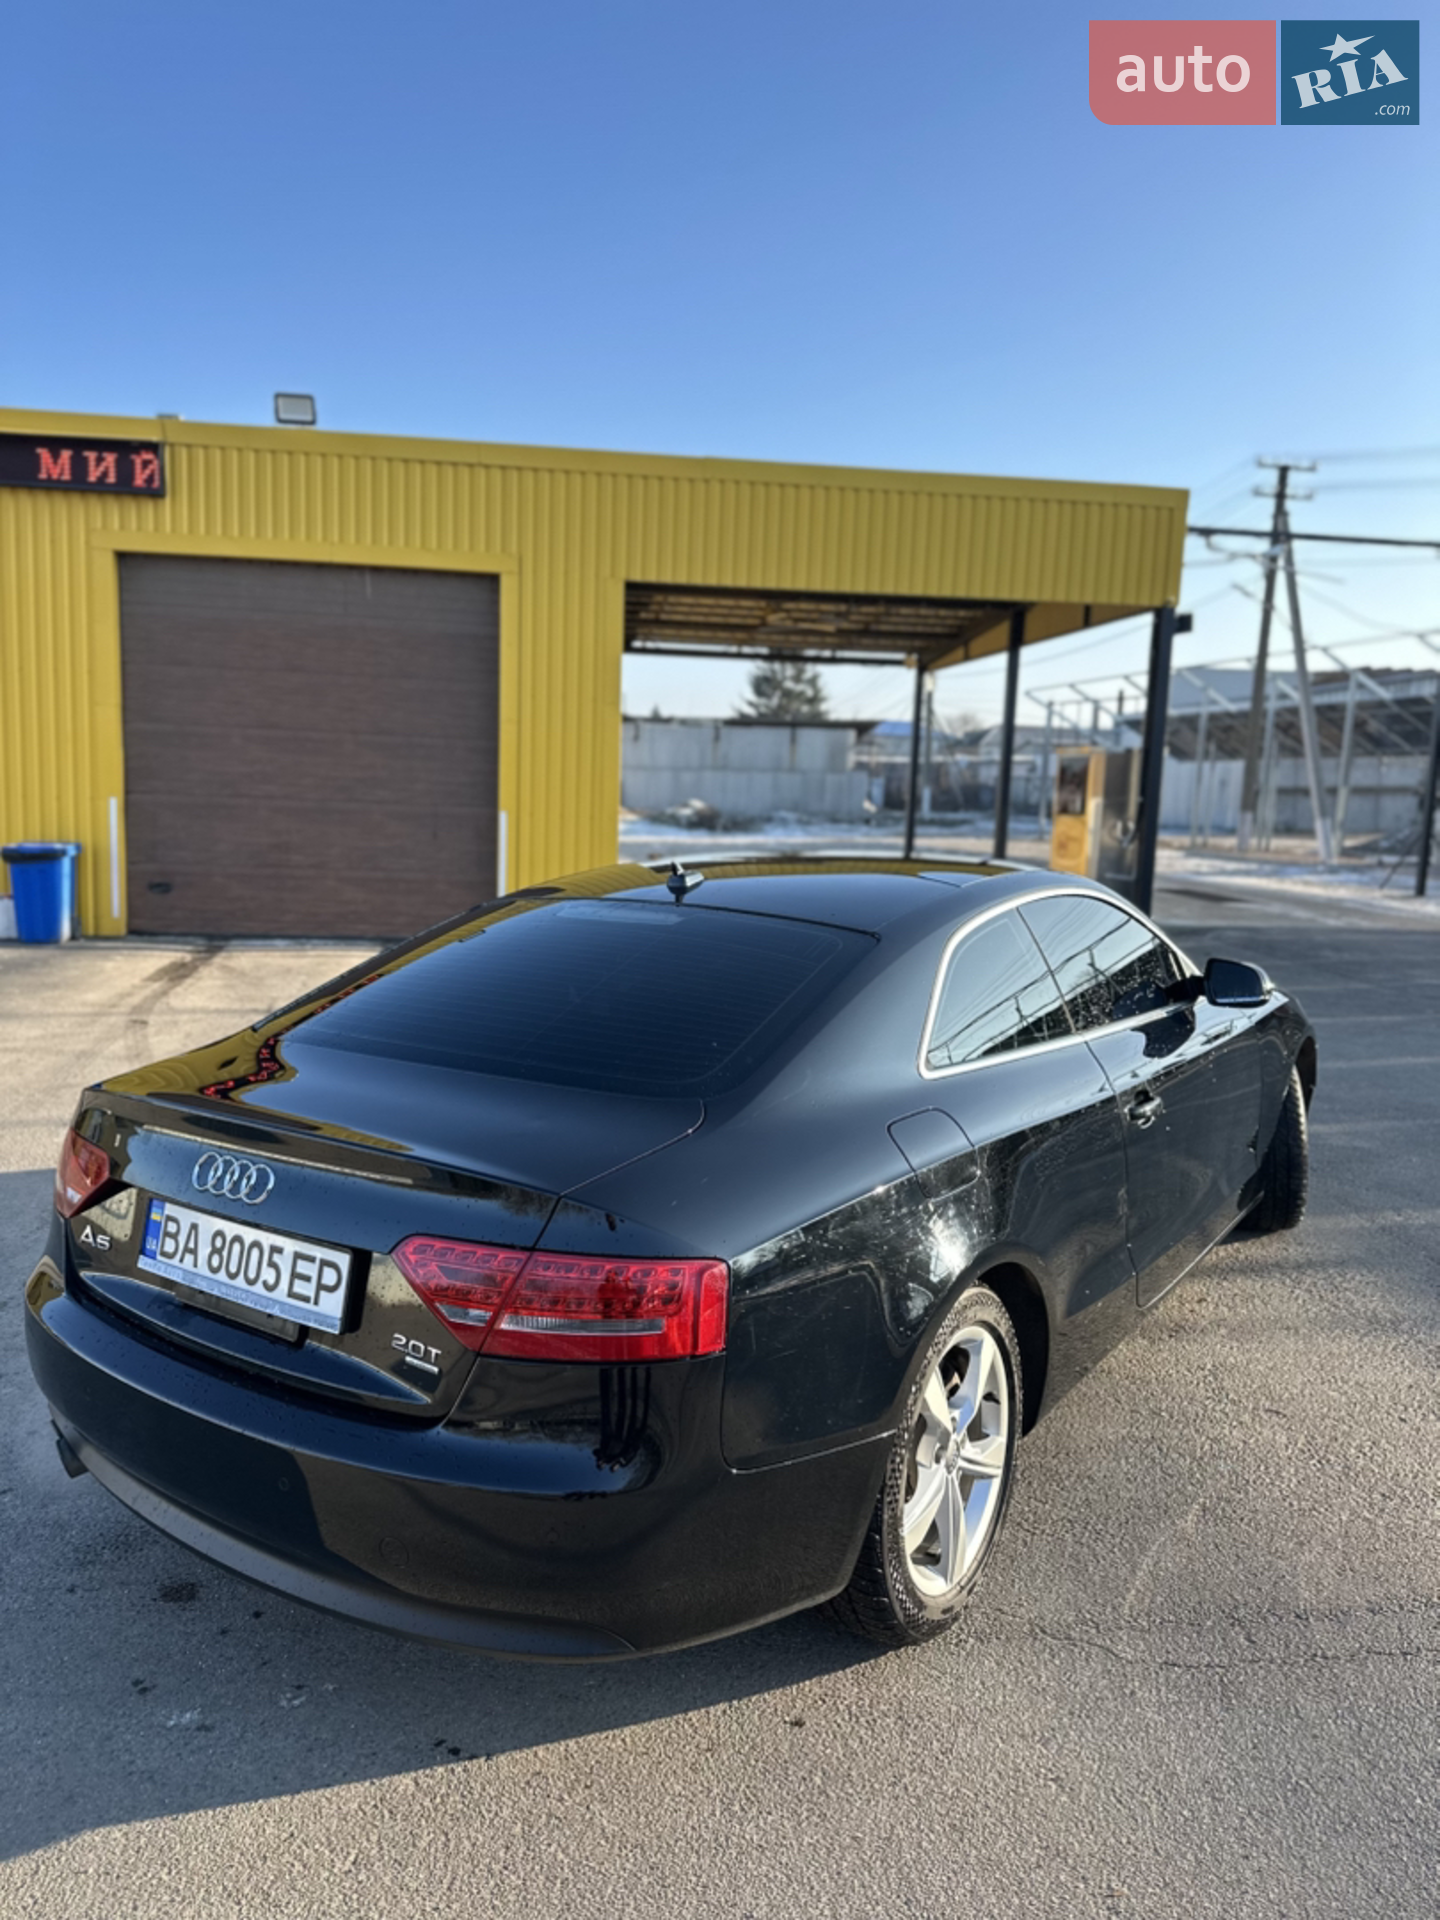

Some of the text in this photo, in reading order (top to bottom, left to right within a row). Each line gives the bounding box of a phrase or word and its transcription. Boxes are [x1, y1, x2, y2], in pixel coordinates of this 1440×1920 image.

[36, 447, 161, 489] МИЙ
[159, 1214, 199, 1268] BA
[207, 1229, 285, 1293] 8005
[287, 1250, 343, 1306] EP
